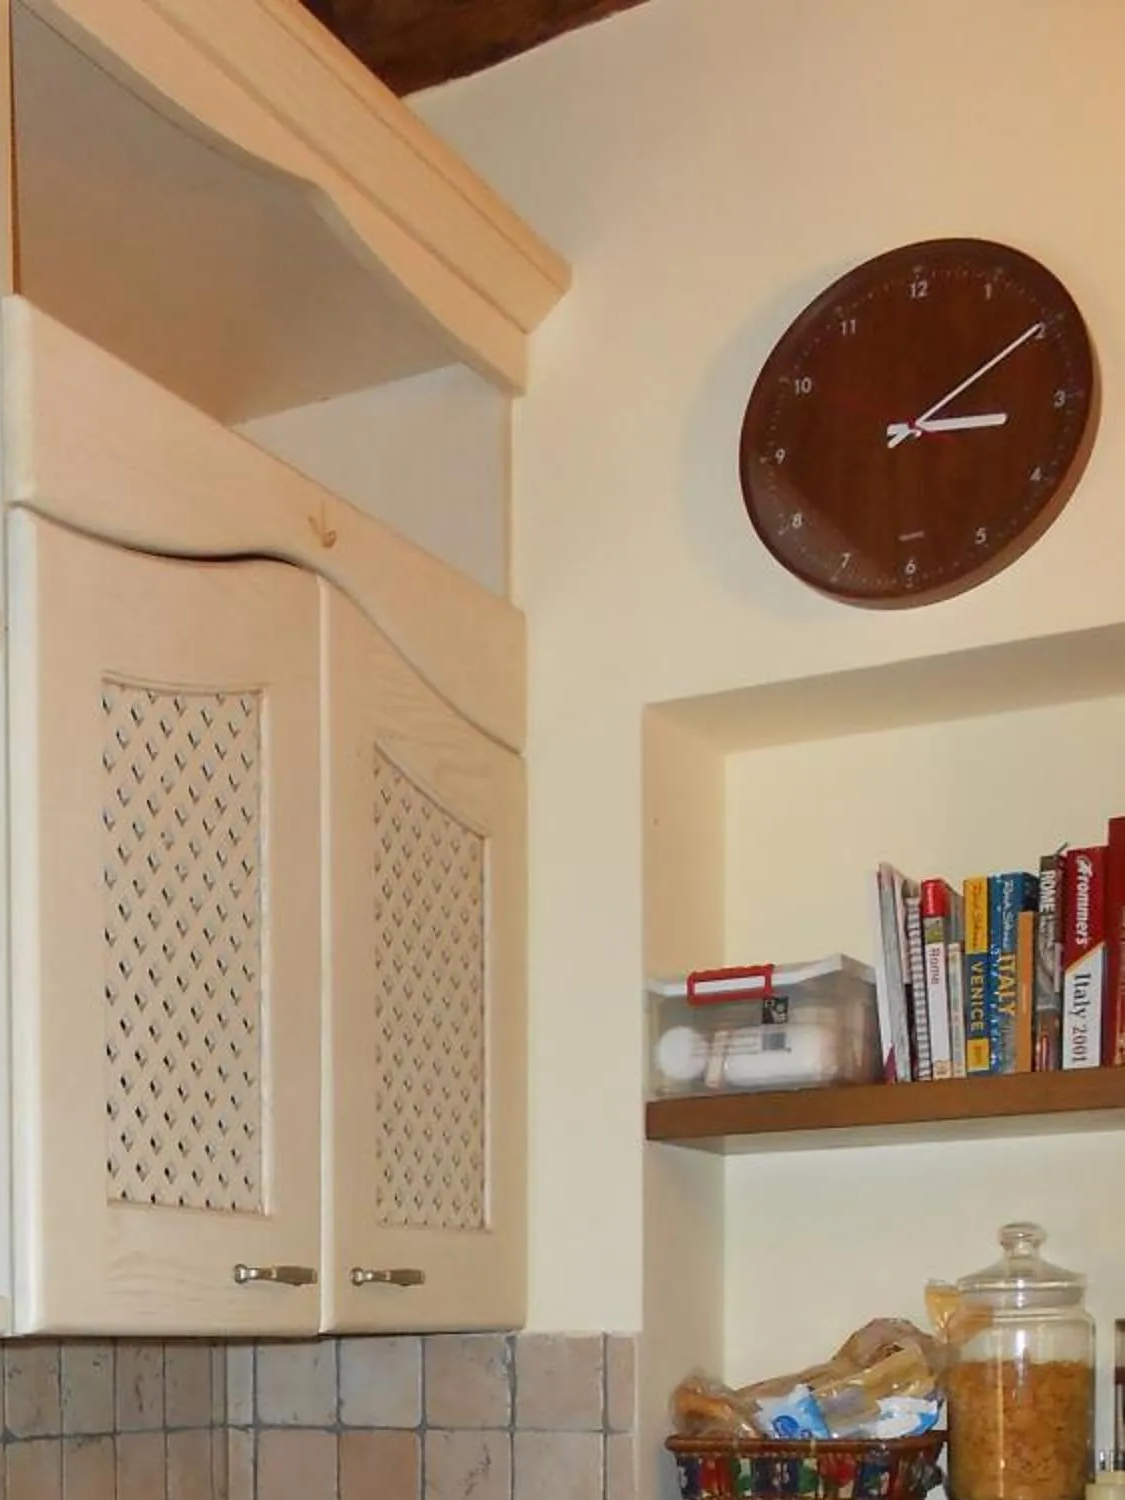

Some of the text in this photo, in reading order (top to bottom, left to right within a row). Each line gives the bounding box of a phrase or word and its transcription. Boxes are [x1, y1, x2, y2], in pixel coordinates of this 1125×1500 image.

[909, 281, 928, 298] 12
[841, 320, 857, 336] 11
[794, 377, 813, 395] 10
[1054, 391, 1067, 408] 3
[775, 448, 786, 464] 9
[1029, 466, 1043, 483] 4
[791, 513, 802, 529] 8
[976, 528, 987, 544] 5
[841, 552, 851, 569] 7
[905, 559, 916, 574] 6
[1039, 870, 1056, 914] ROME
[1076, 856, 1093, 949] Frommer's
[998, 953, 1016, 1017] ITALY
[970, 961, 984, 1032] VENICE
[1069, 973, 1091, 1062] Italy 2001
